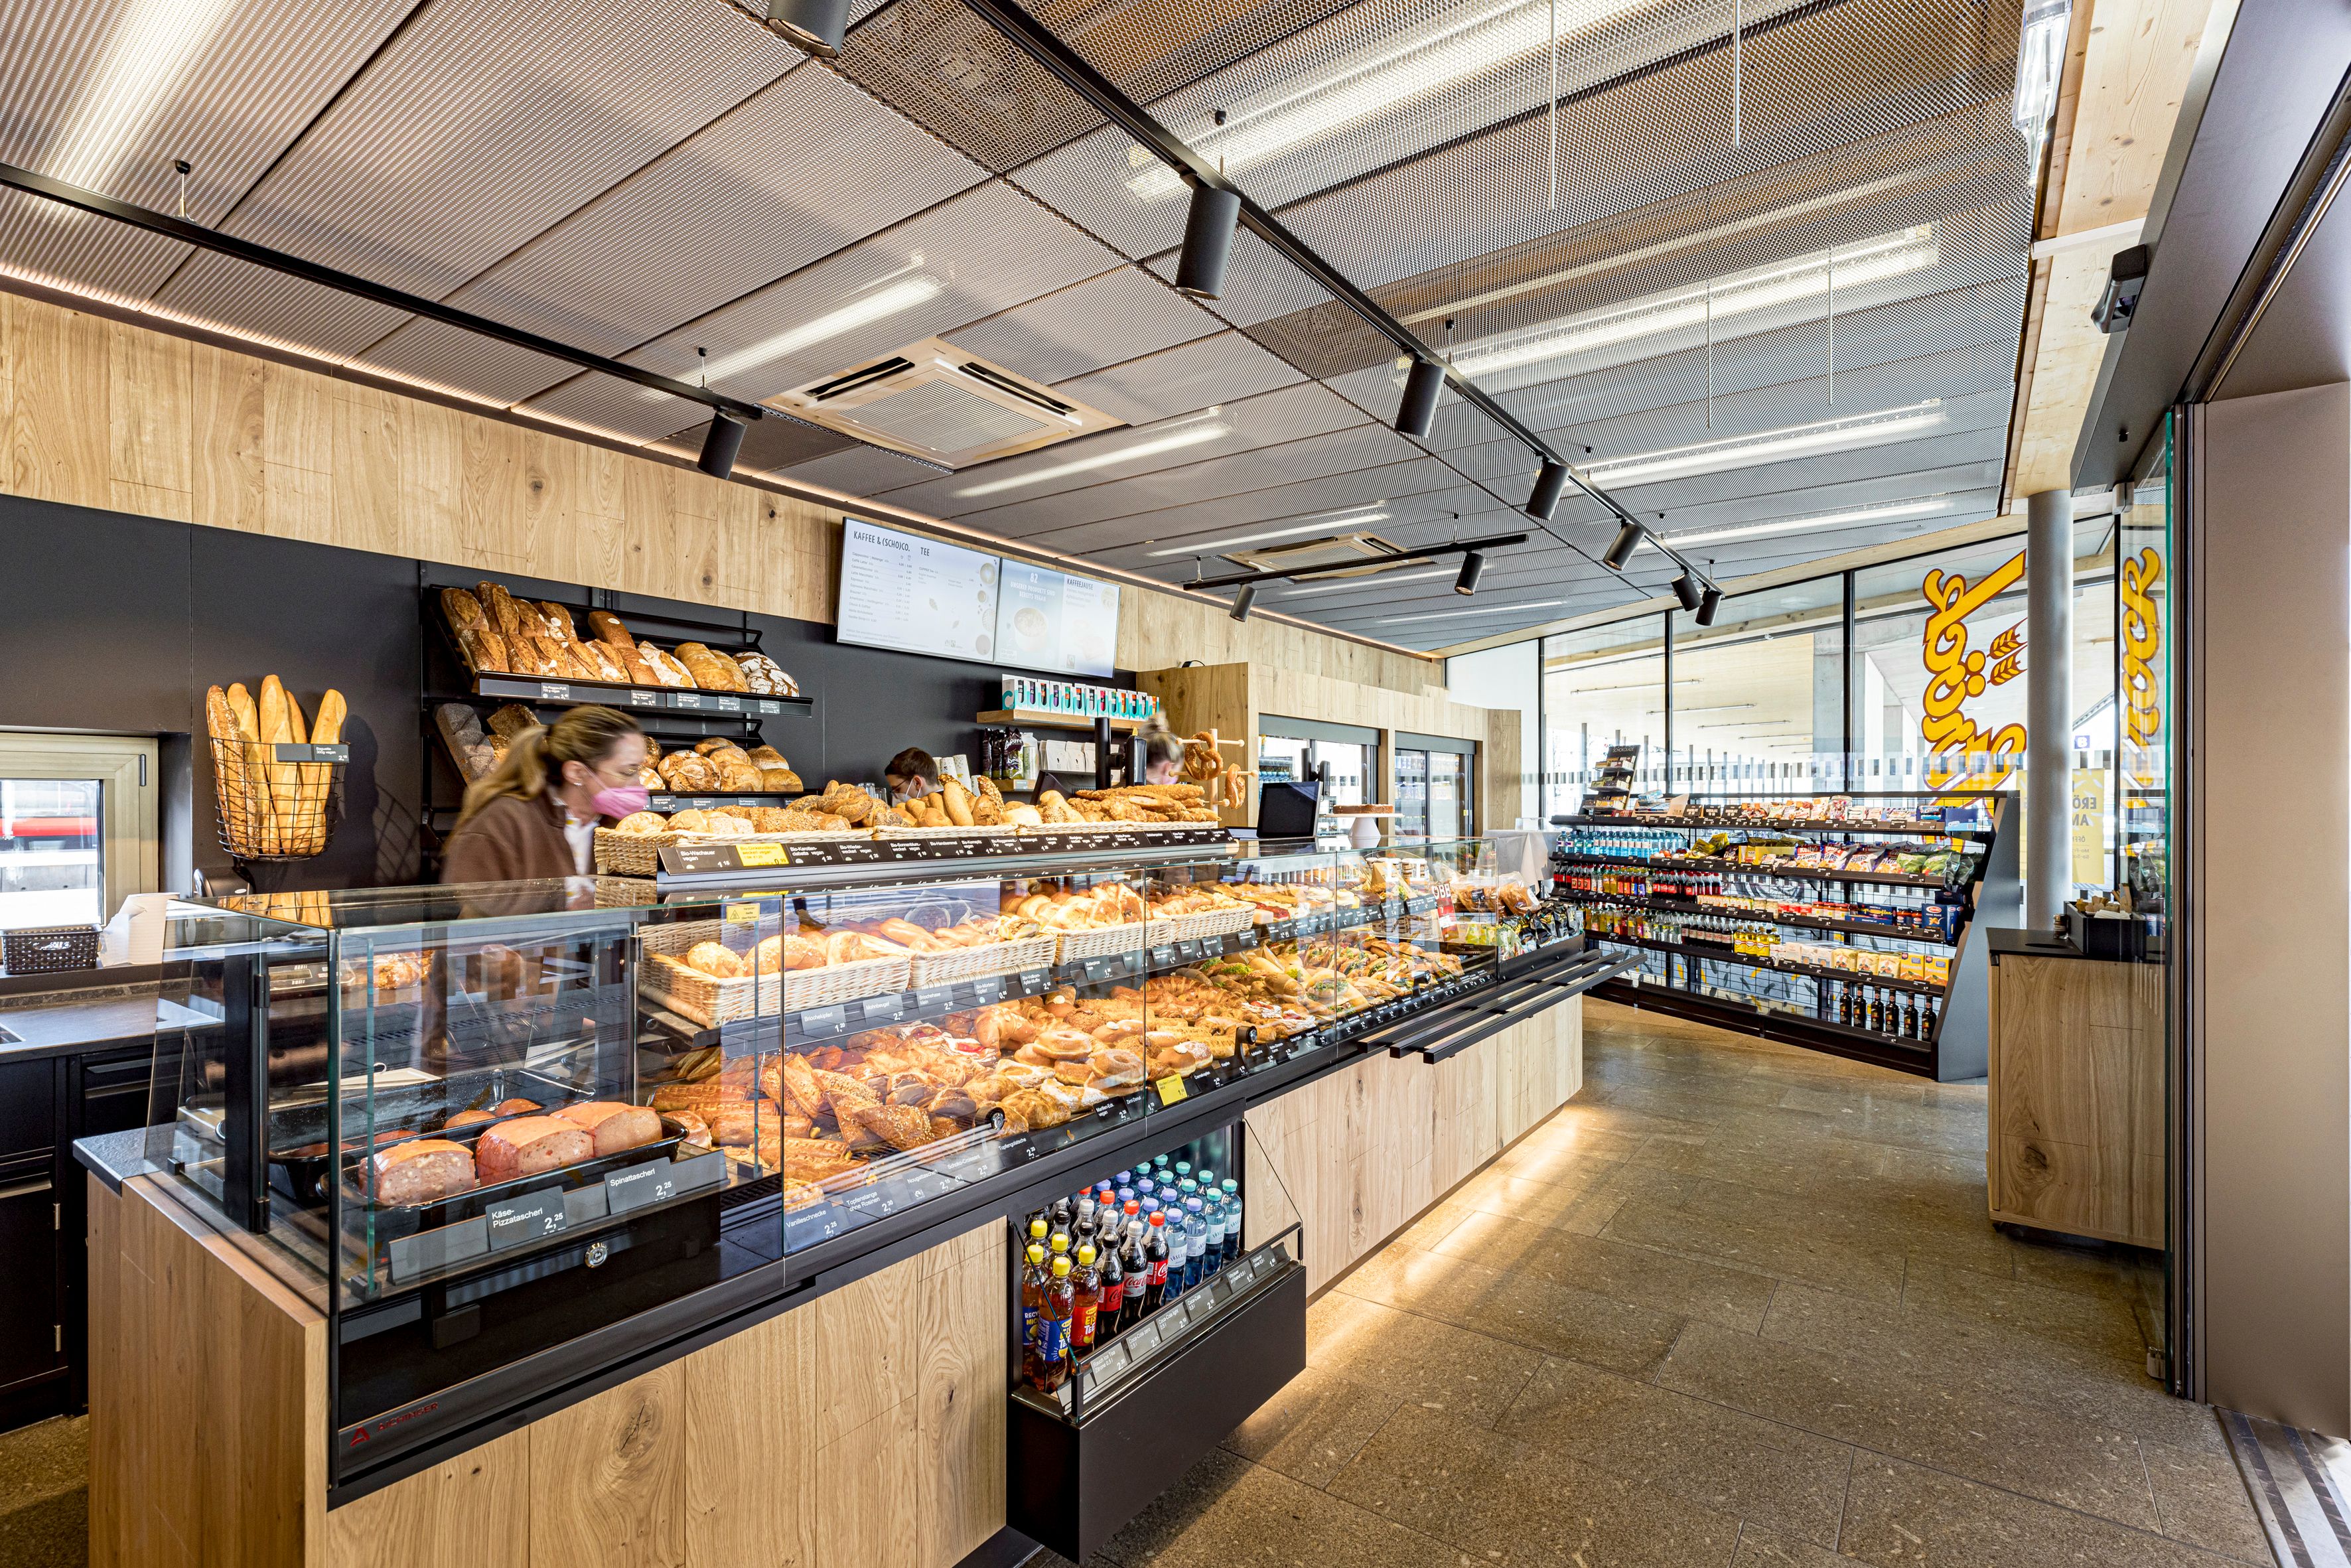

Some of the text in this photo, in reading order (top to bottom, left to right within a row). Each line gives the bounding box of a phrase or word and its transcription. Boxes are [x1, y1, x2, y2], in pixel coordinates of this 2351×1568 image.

[853, 531, 910, 551] KAFFEE & (SCHO)CO.
[920, 547, 930, 556] TEE
[1030, 573, 1038, 583] 82
[1066, 578, 1094, 591] KAFFEEJAUSE
[2077, 737, 2088, 748] B
[865, 1001, 890, 1011] Mohnbeugel
[804, 1012, 833, 1023] Briochekipferl
[998, 1137, 1027, 1151] Topfengolatsche
[947, 1155, 981, 1170] Schoko-Croissant
[610, 1168, 656, 1186] Spinattascherl
[656, 1180, 672, 1197] 2,25
[846, 1190, 878, 1207] Topfenstange
[849, 1196, 893, 1213] ohne Rosinen 2,30
[492, 1207, 515, 1220] Käse-
[492, 1207, 563, 1230] Pizzatascherl 2,25
[786, 1208, 837, 1235] Vanilleschnecke 2,25
[1187, 1295, 1201, 1305] Coca-Cola
[1158, 1313, 1173, 1325] Coca-Cola
[1128, 1332, 1144, 1344] Coca-Cola
[1093, 1359, 1104, 1368] Rauch
[1094, 1363, 1106, 1374] Zitrone
[377, 1401, 439, 1432] AICHINGER
